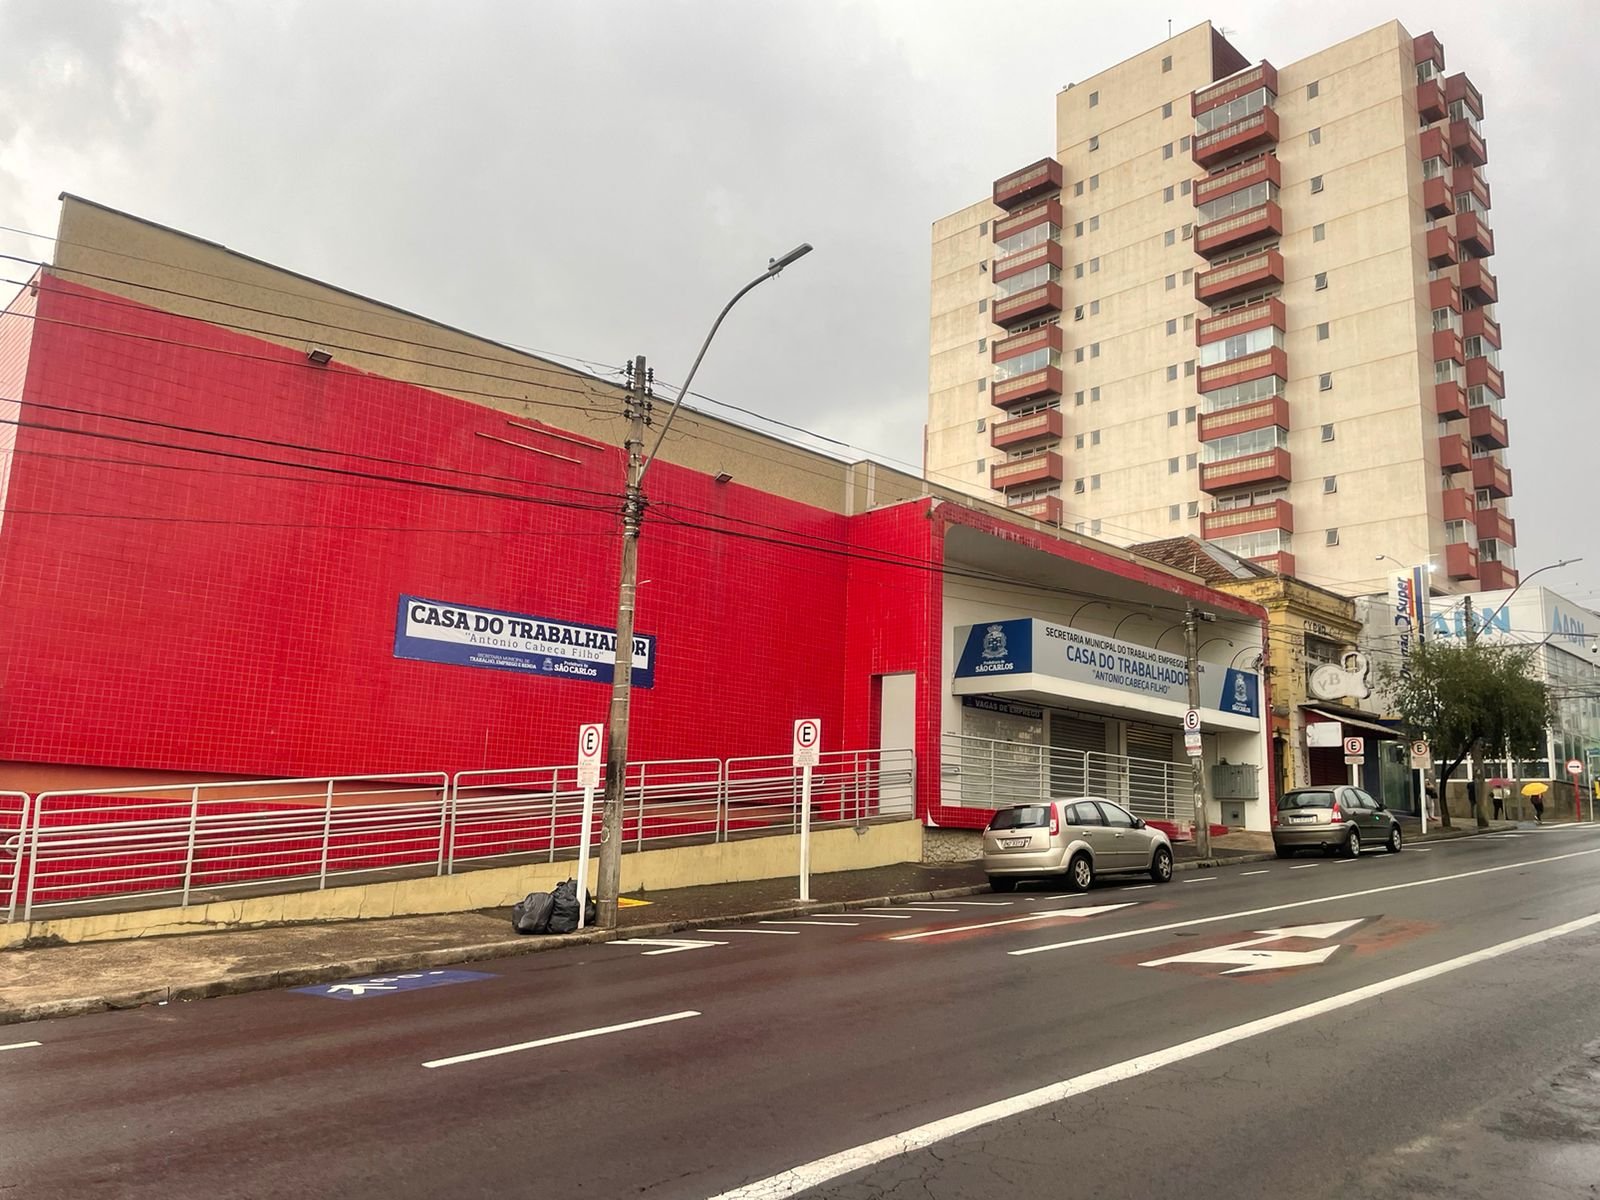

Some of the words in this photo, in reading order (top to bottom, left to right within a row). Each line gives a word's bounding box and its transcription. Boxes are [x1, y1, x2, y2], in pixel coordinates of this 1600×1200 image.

[411, 604, 470, 631] CASA
[474, 615, 504, 635] DO
[465, 632, 519, 648] "Antonio
[571, 648, 604, 660] Filho"
[1045, 626, 1085, 644] SECRETARIA
[1085, 637, 1117, 652] MUNICIPAL
[1117, 644, 1126, 654] DO
[1158, 655, 1184, 669] EMPREGO
[553, 663, 570, 674] SÃO
[569, 665, 598, 677] CARLOS
[975, 664, 988, 673] SÃO
[988, 662, 1014, 671] CARLOS
[1066, 645, 1097, 667] CASA
[1098, 652, 1115, 670] DO
[1117, 657, 1189, 687] TRABALHADOR
[1092, 669, 1124, 685] "ANTONIO
[1150, 681, 1171, 695] FILHO"
[975, 700, 998, 710] VAGAS
[998, 704, 1008, 713] DE
[1189, 714, 1195, 725] E
[586, 732, 594, 750] E
[803, 726, 811, 742] E
[1351, 741, 1356, 750] E
[1417, 744, 1423, 753] E
